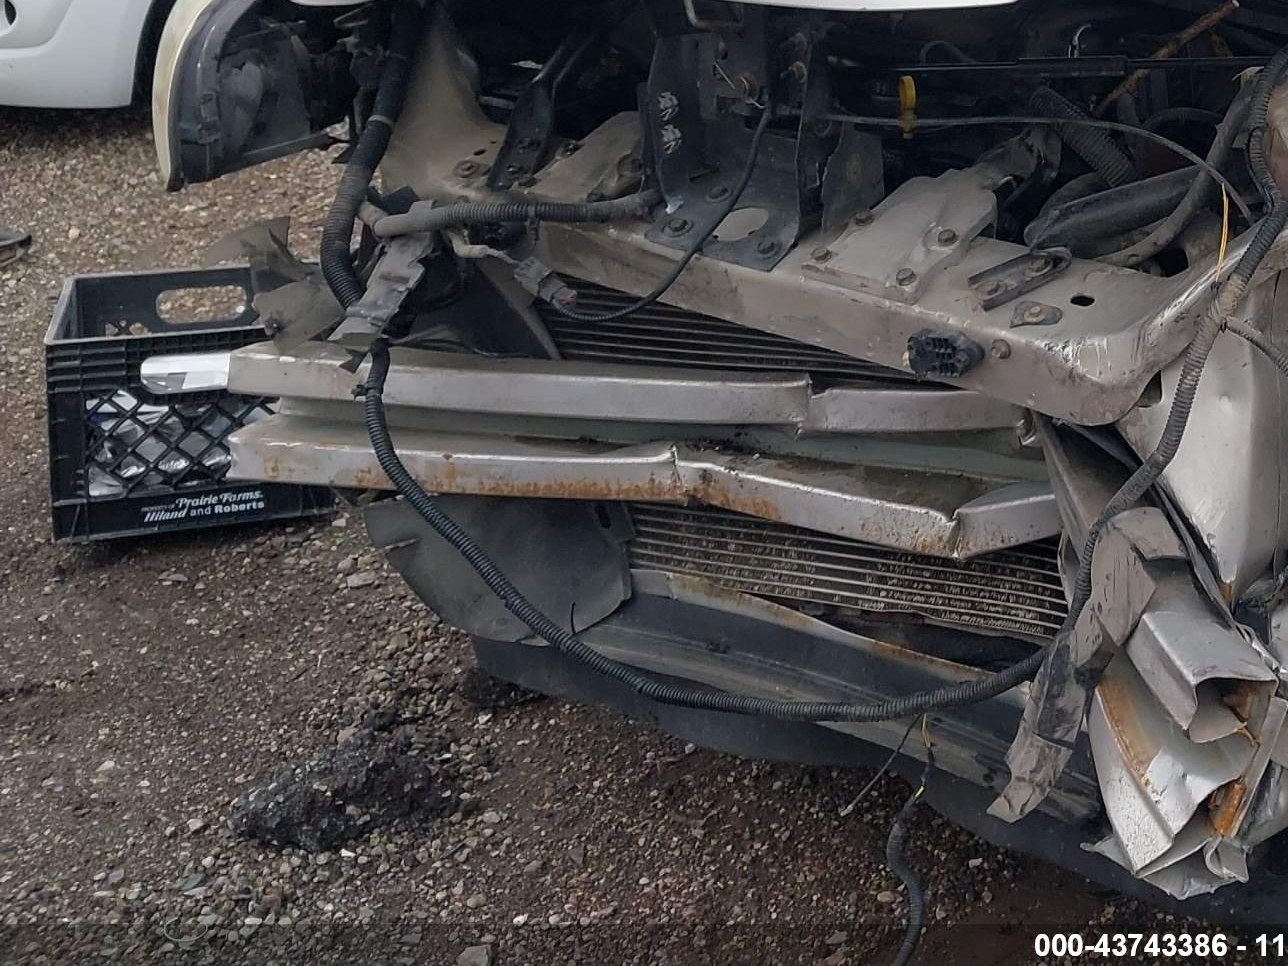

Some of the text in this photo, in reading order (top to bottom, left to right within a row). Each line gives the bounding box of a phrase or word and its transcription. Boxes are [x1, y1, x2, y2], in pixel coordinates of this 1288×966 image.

[175, 495, 219, 509] Prairie
[190, 506, 211, 517] and
[214, 501, 265, 514] Roberts
